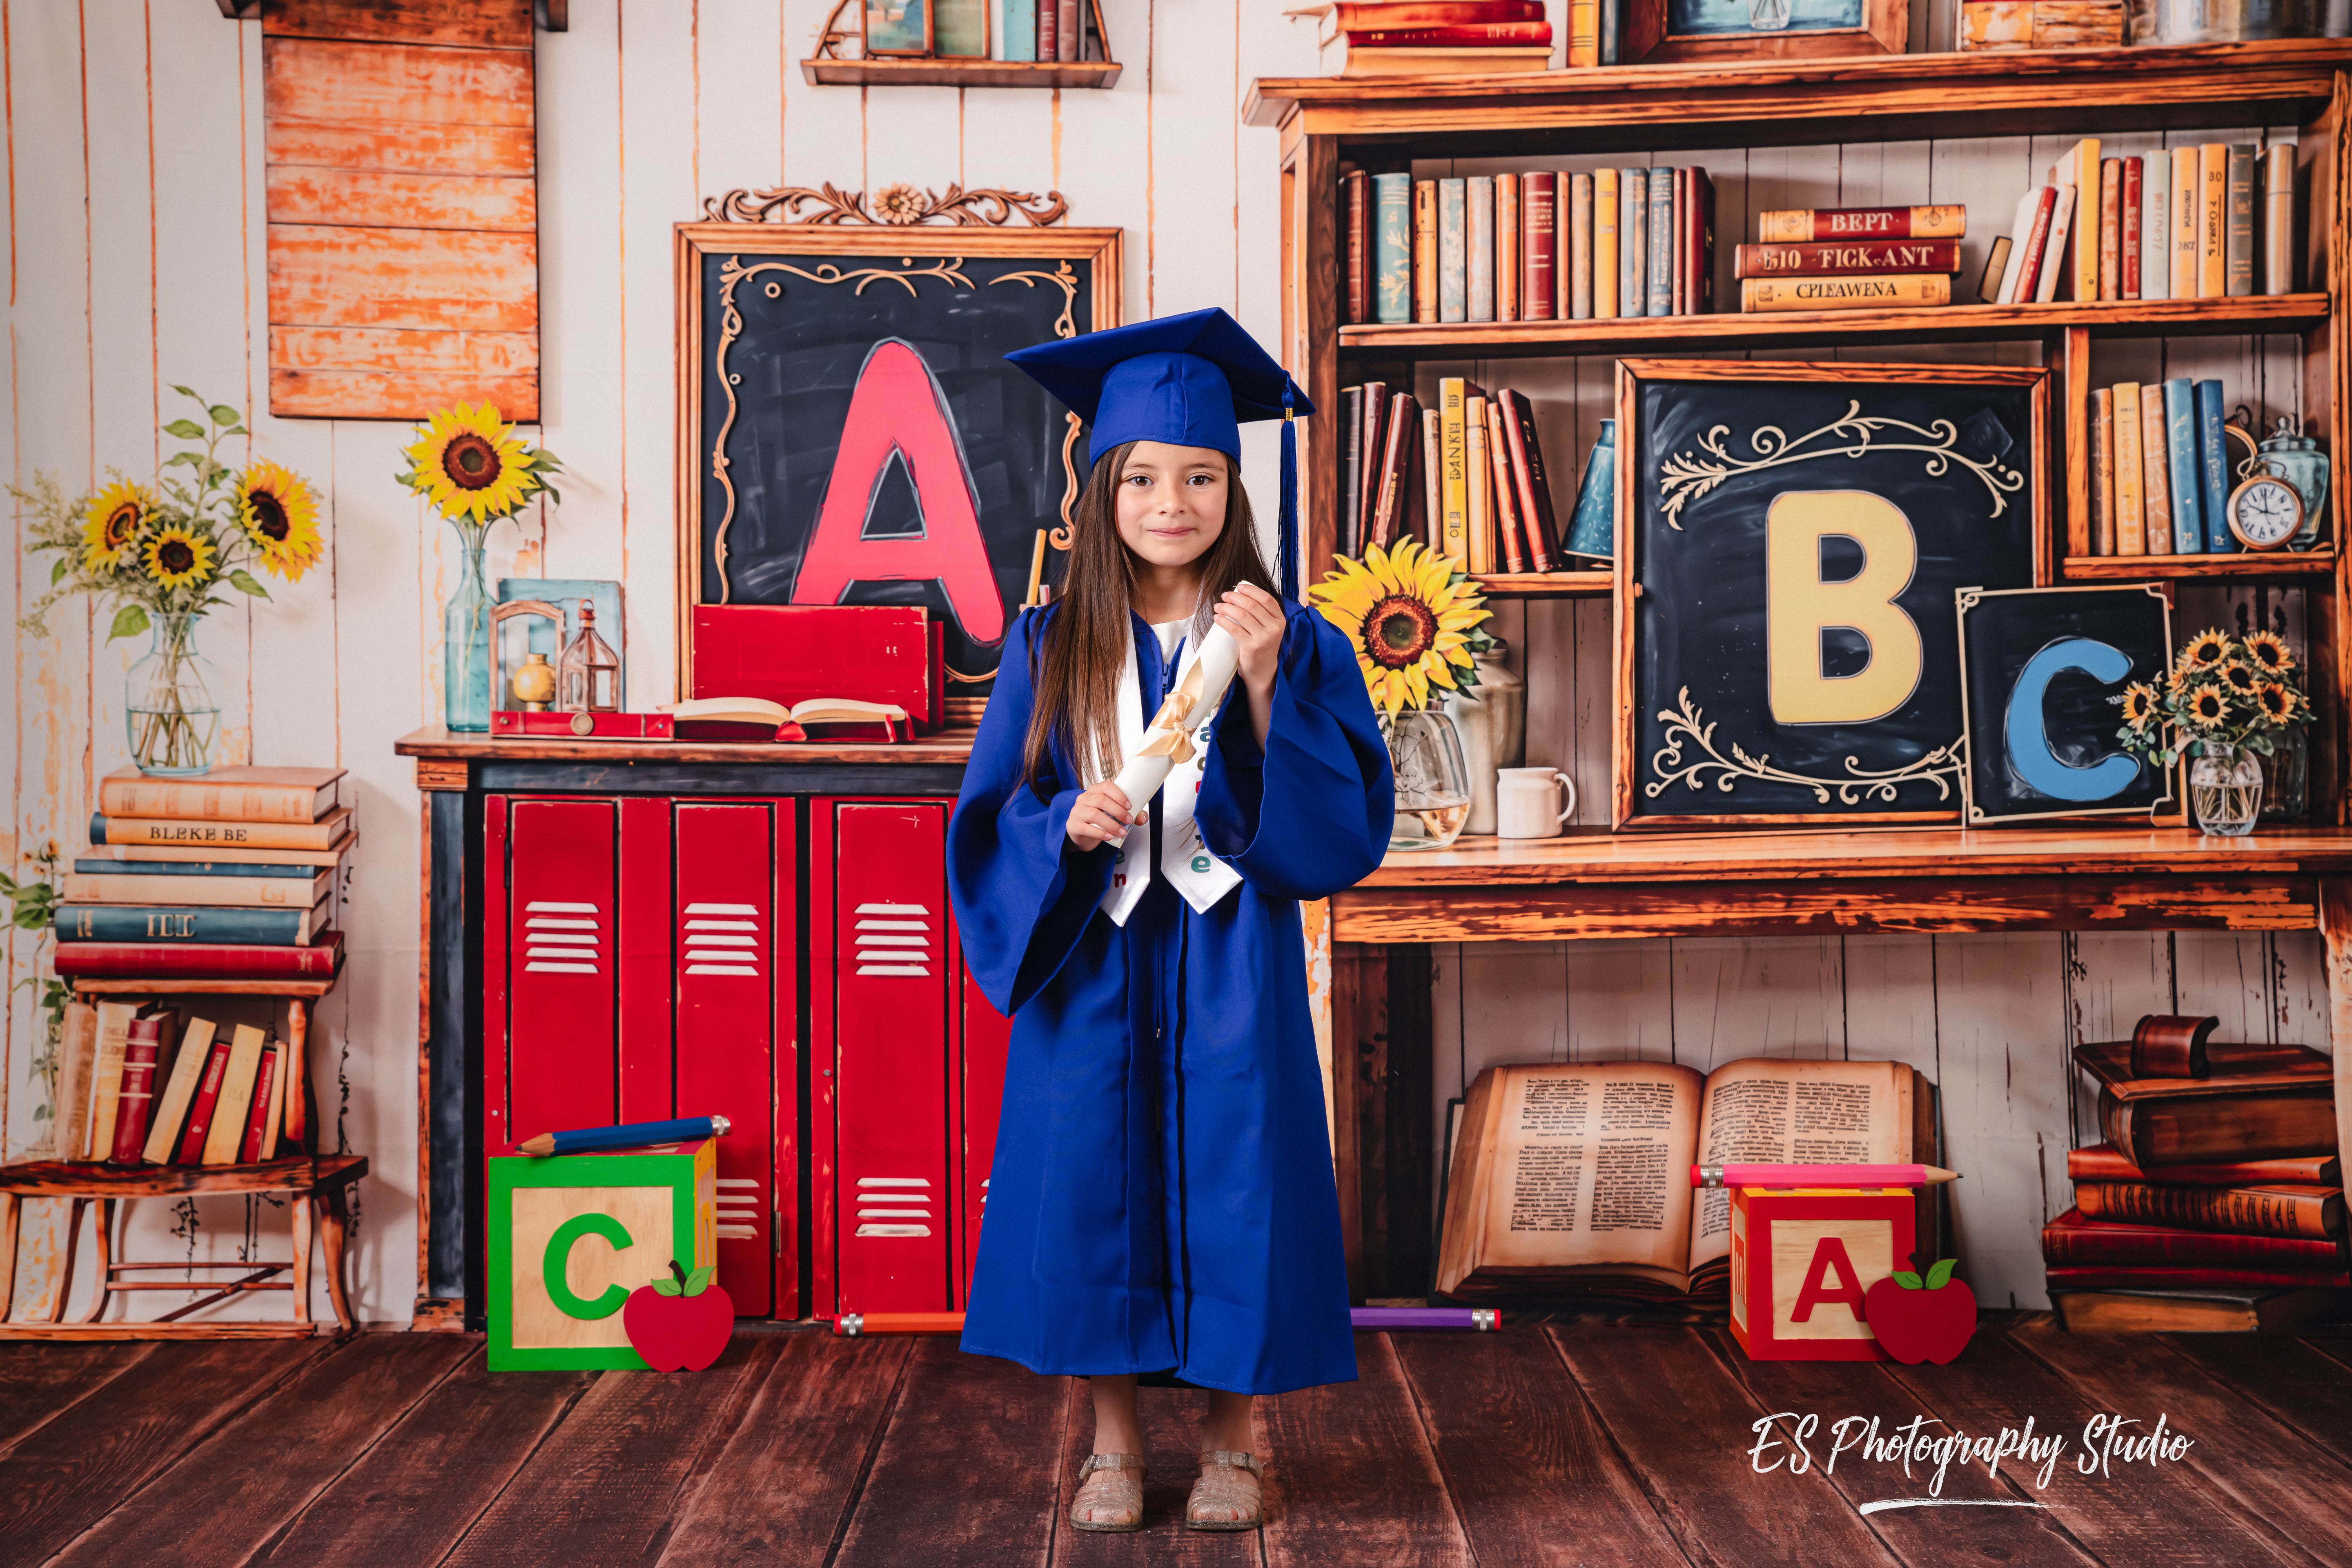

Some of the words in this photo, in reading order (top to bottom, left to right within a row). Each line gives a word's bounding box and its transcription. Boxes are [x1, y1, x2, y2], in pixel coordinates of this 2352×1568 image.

[1831, 212, 1893, 232] BEPT
[791, 337, 1004, 645] A
[1766, 490, 1922, 725] B
[2004, 635, 2140, 801] C
[224, 829, 247, 841] BE
[543, 1213, 633, 1320] C
[1791, 1237, 1868, 1322] A
